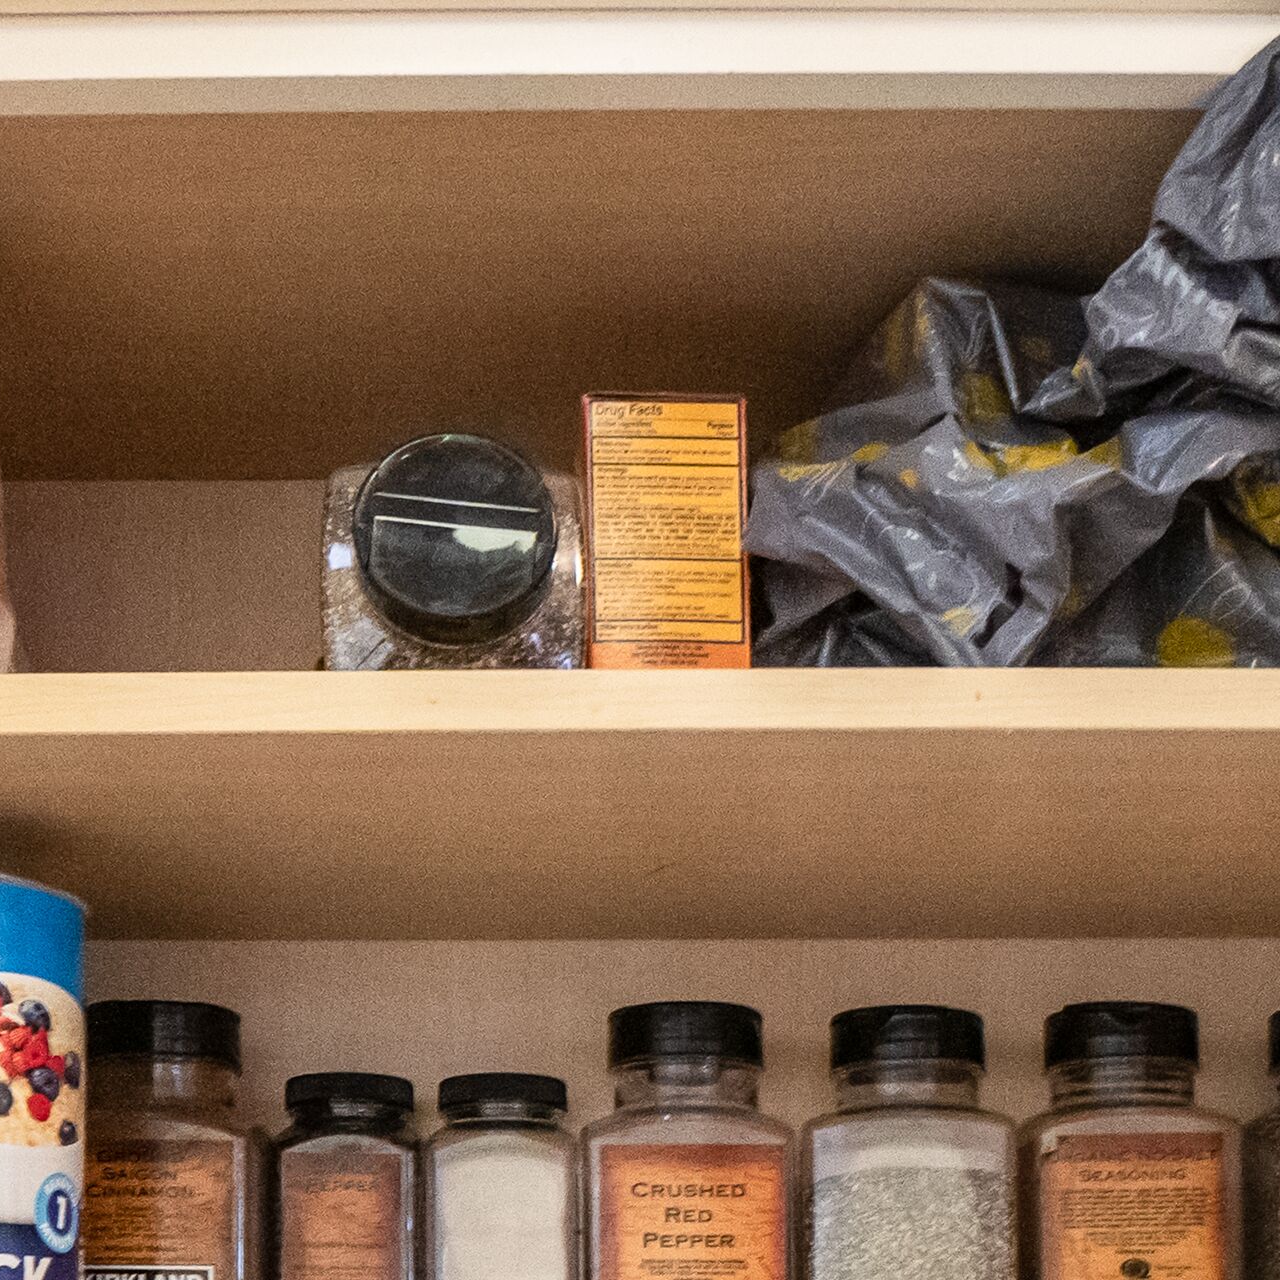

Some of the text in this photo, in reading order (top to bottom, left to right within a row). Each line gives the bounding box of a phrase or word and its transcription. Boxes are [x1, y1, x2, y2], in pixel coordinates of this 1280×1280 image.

[595, 403, 663, 418] Drug Facts
[630, 1182, 747, 1199] CRUSHED
[664, 1207, 714, 1224] RED
[643, 1231, 736, 1249] PEPPER
